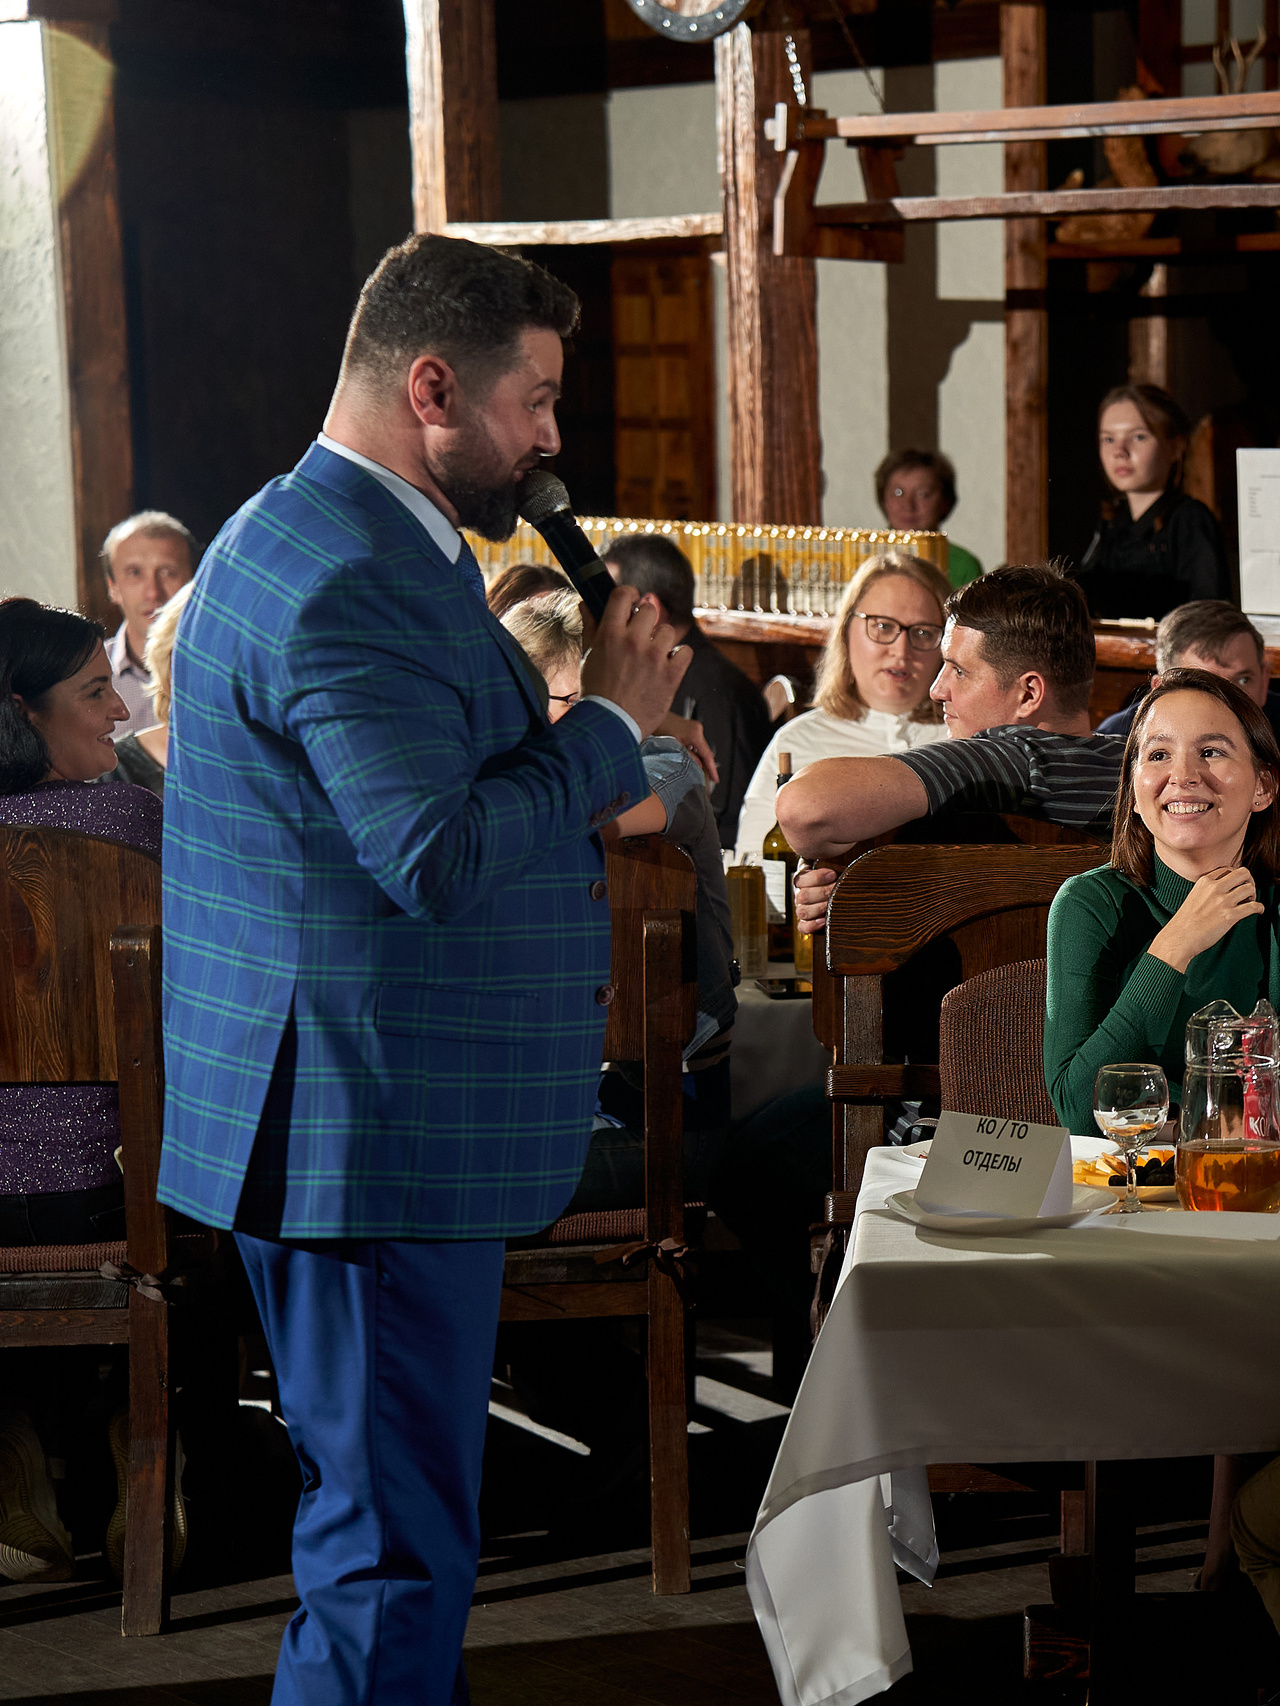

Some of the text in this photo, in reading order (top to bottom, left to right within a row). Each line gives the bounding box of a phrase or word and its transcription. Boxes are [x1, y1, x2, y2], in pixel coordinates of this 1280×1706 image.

[976, 1117, 997, 1134] КО
[1010, 1122, 1029, 1140] ТО
[963, 1149, 1022, 1173] ОТДЕЛЫ
